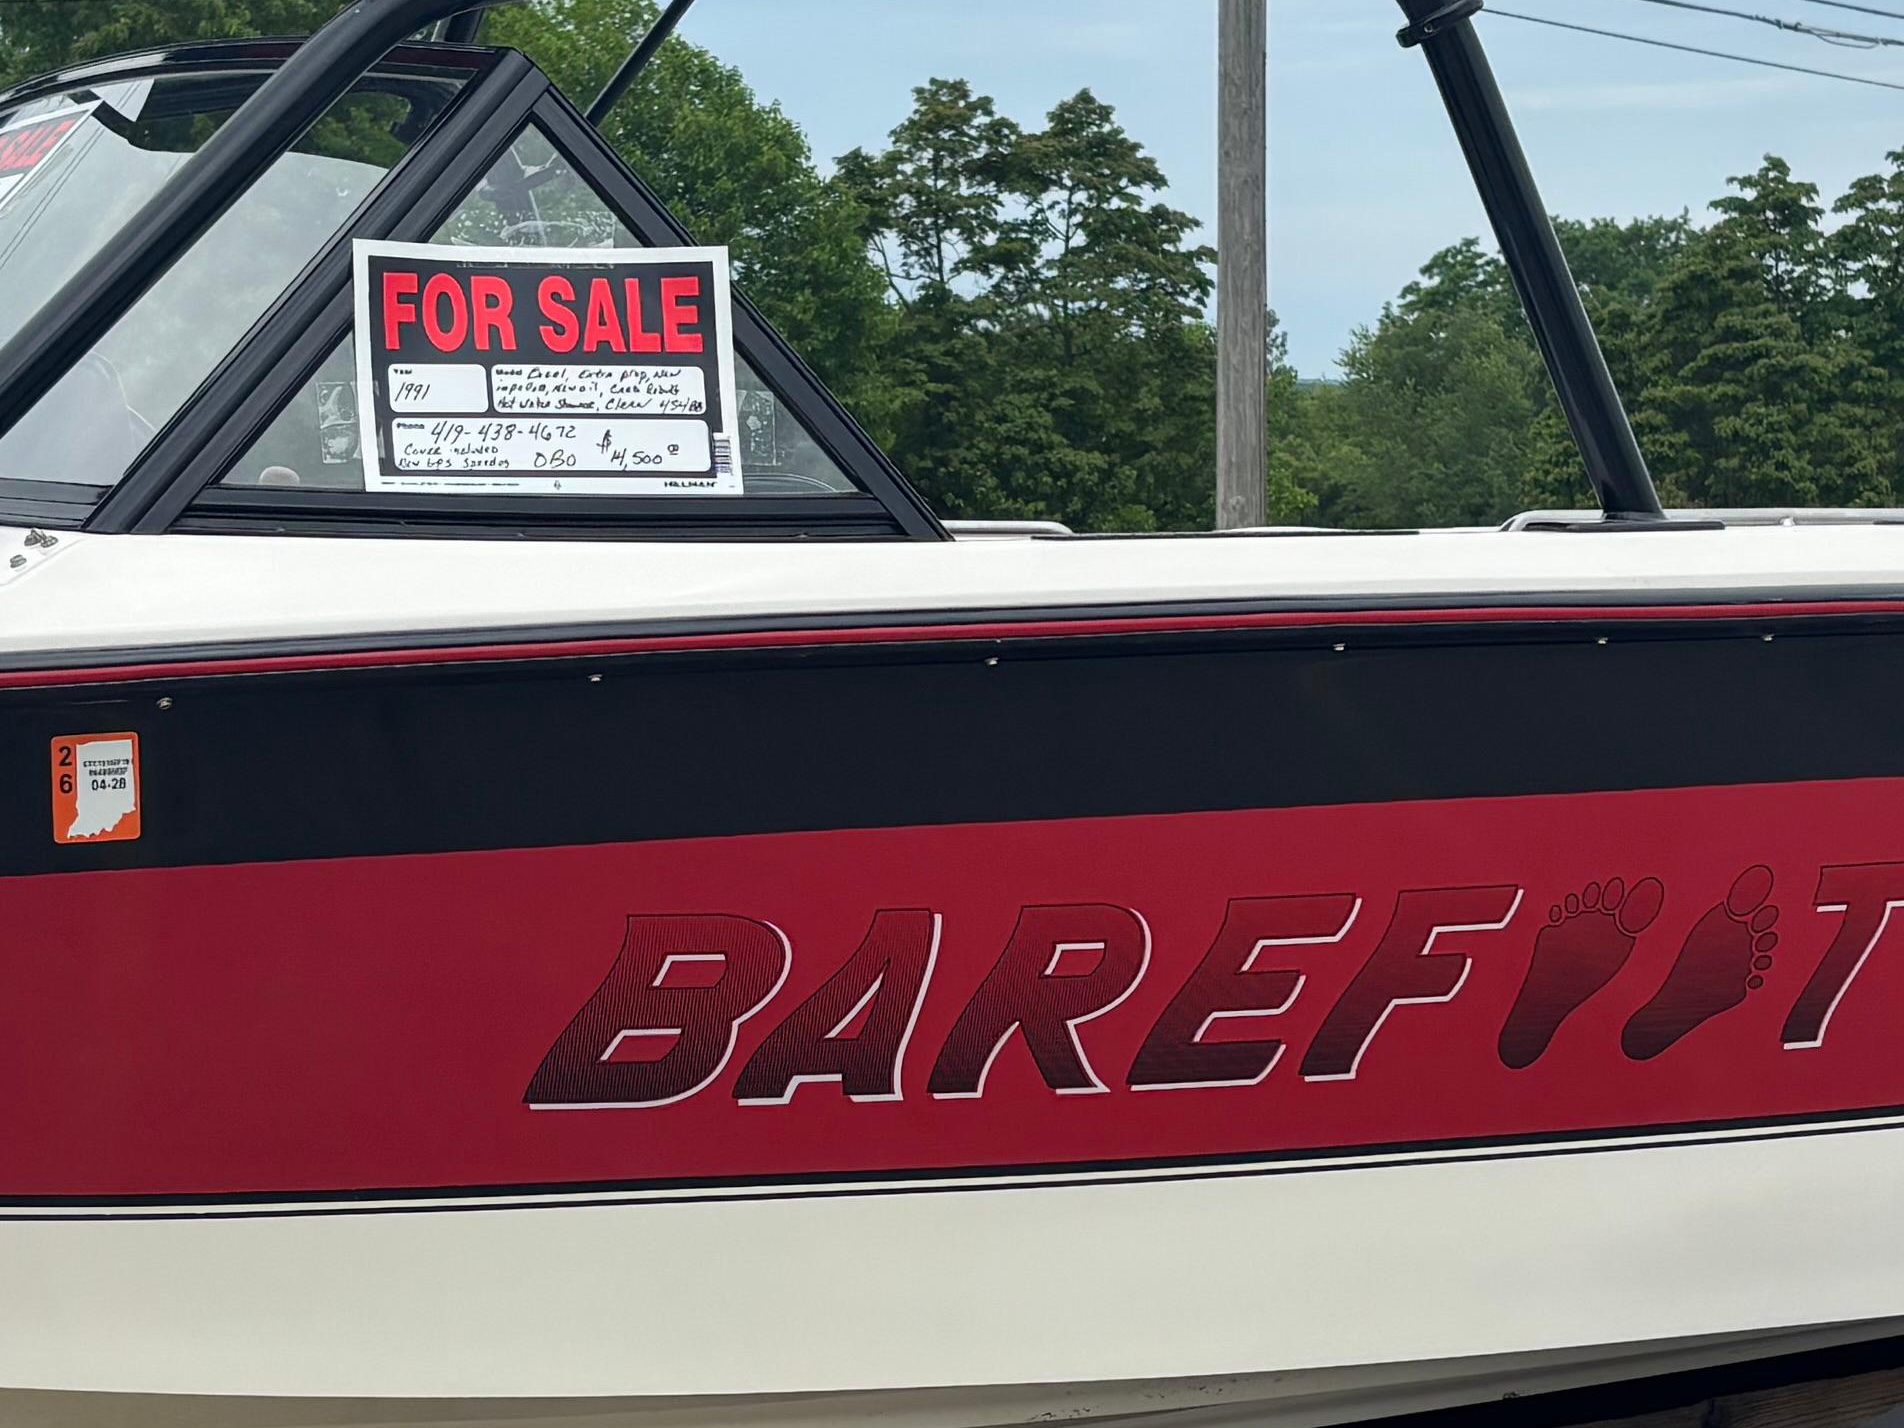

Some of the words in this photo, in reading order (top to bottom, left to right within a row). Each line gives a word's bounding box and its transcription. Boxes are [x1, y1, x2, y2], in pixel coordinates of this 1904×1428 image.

[382, 271, 518, 352] FOR
[537, 275, 704, 353] SALE
[395, 382, 431, 402] 1991
[431, 421, 577, 445] 419-438-4672
[533, 449, 577, 469] OBO
